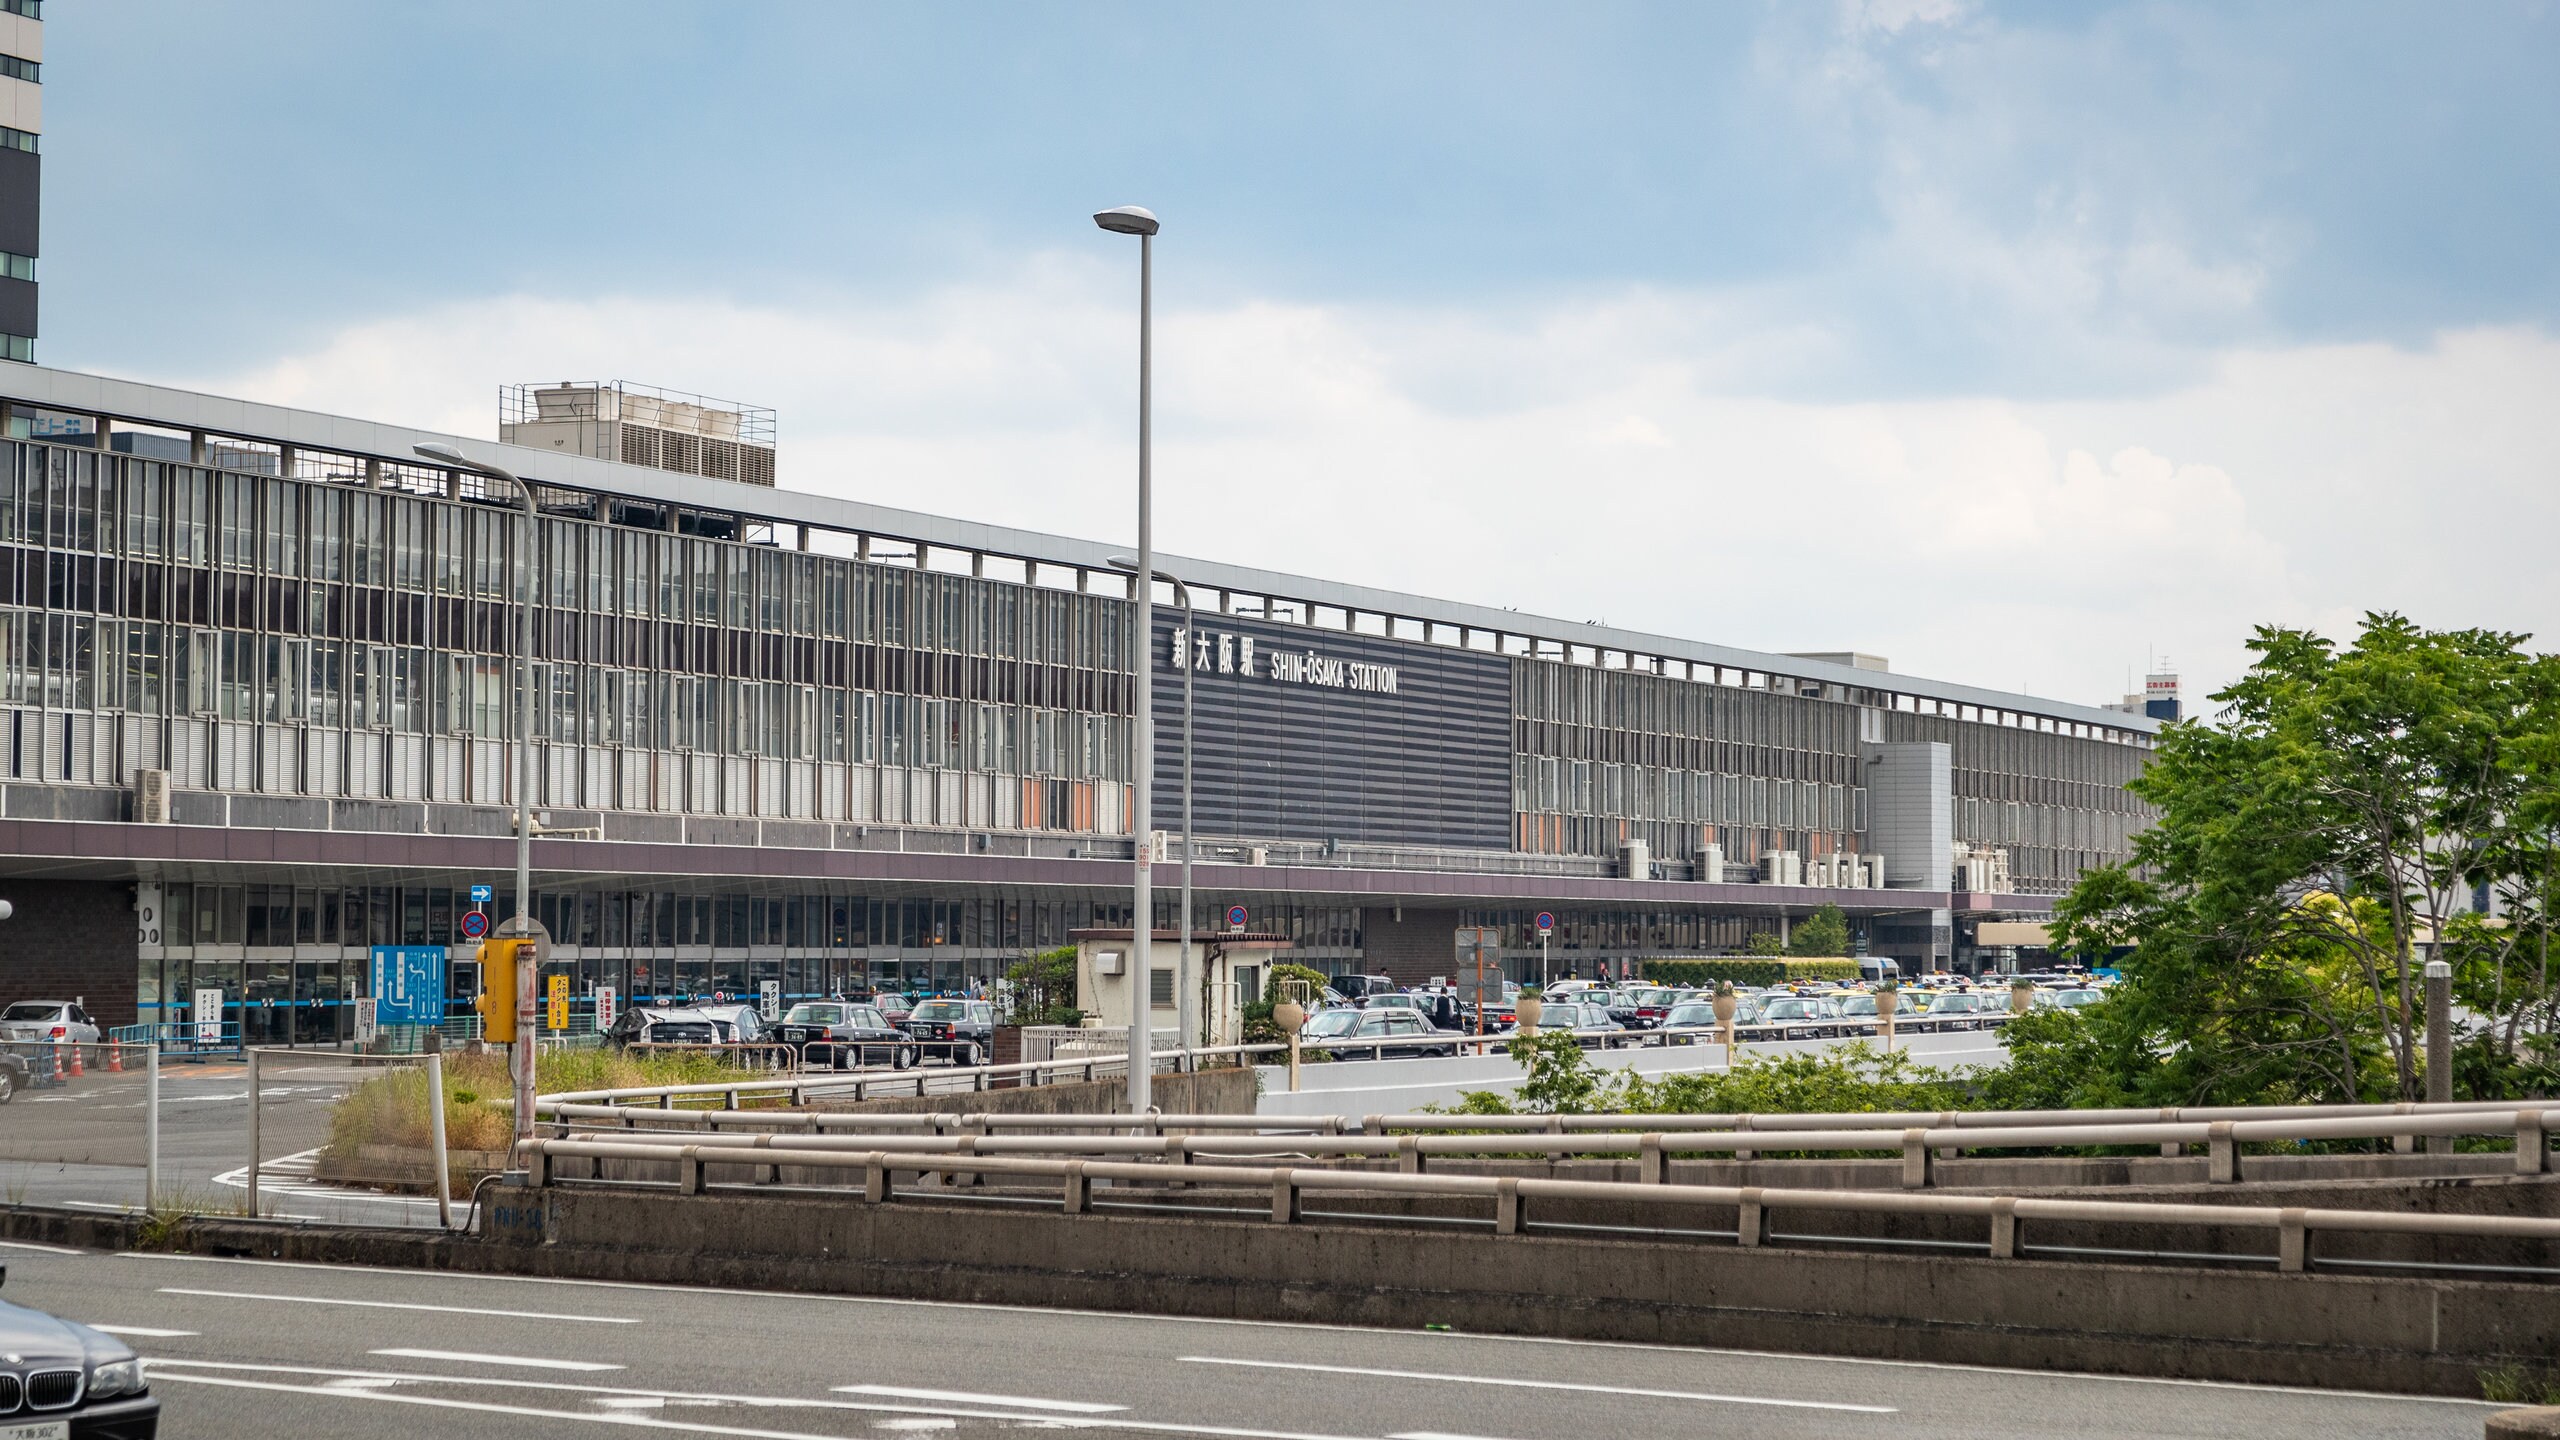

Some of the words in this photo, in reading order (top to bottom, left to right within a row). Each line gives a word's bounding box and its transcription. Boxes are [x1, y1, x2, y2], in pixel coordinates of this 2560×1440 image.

[1172, 627, 1255, 676] 新大阪駅
[1270, 650, 1344, 688] SHIN-ŌSAKA
[1349, 662, 1397, 694] STATION
[770, 983, 778, 1014] タクシー
